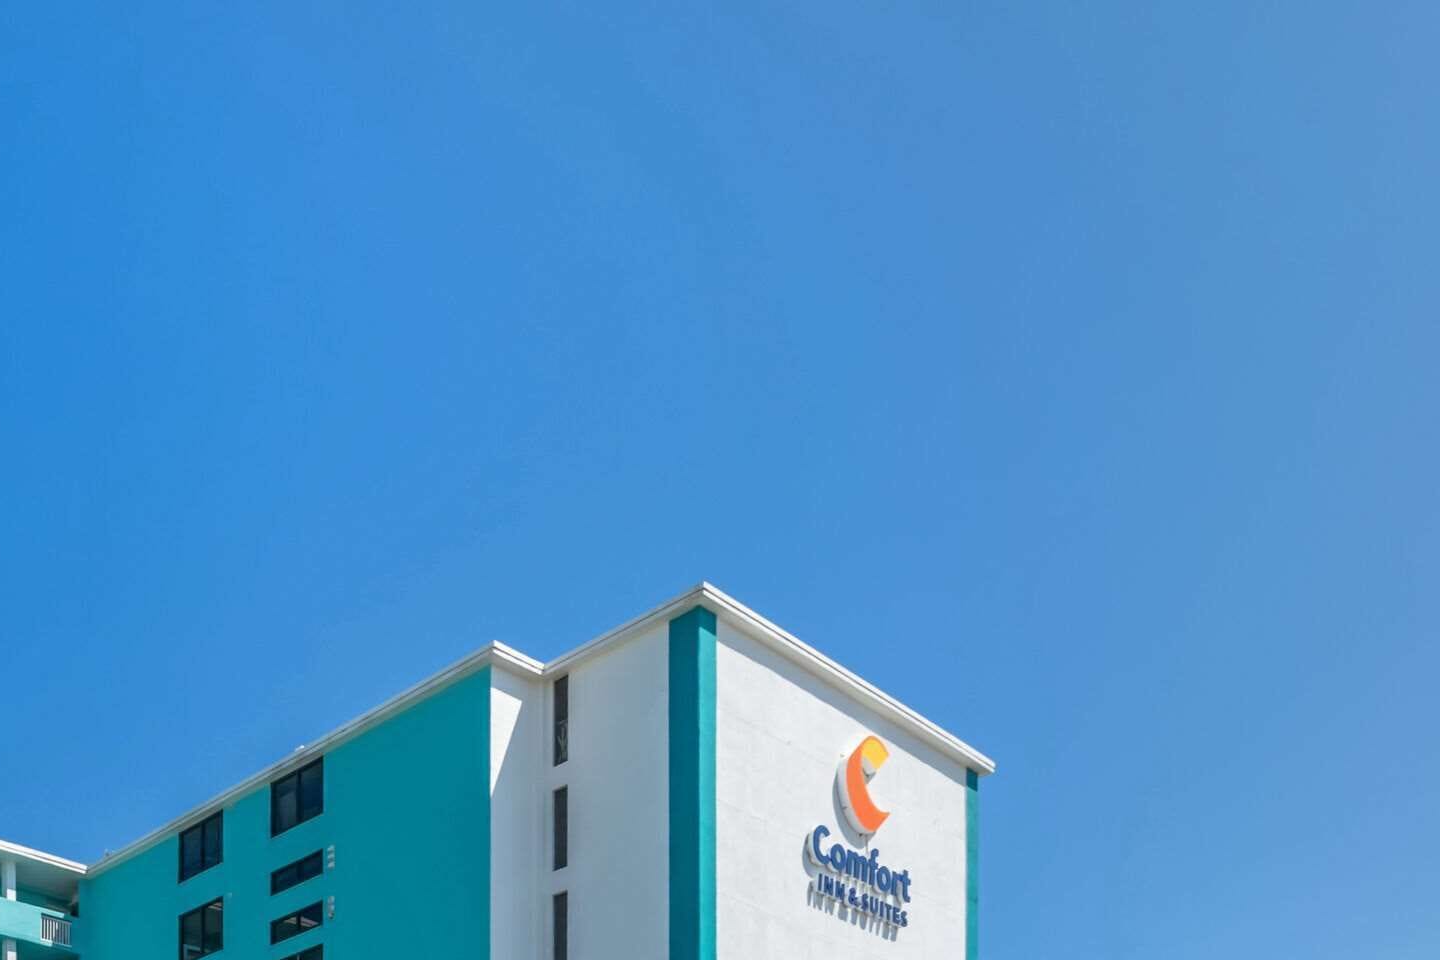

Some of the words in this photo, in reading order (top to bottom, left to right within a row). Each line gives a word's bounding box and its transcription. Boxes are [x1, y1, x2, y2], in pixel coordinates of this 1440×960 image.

[812, 825, 912, 903] Comfort
[817, 873, 845, 901] INN
[848, 887, 860, 906] &
[860, 893, 908, 927] SUITES
